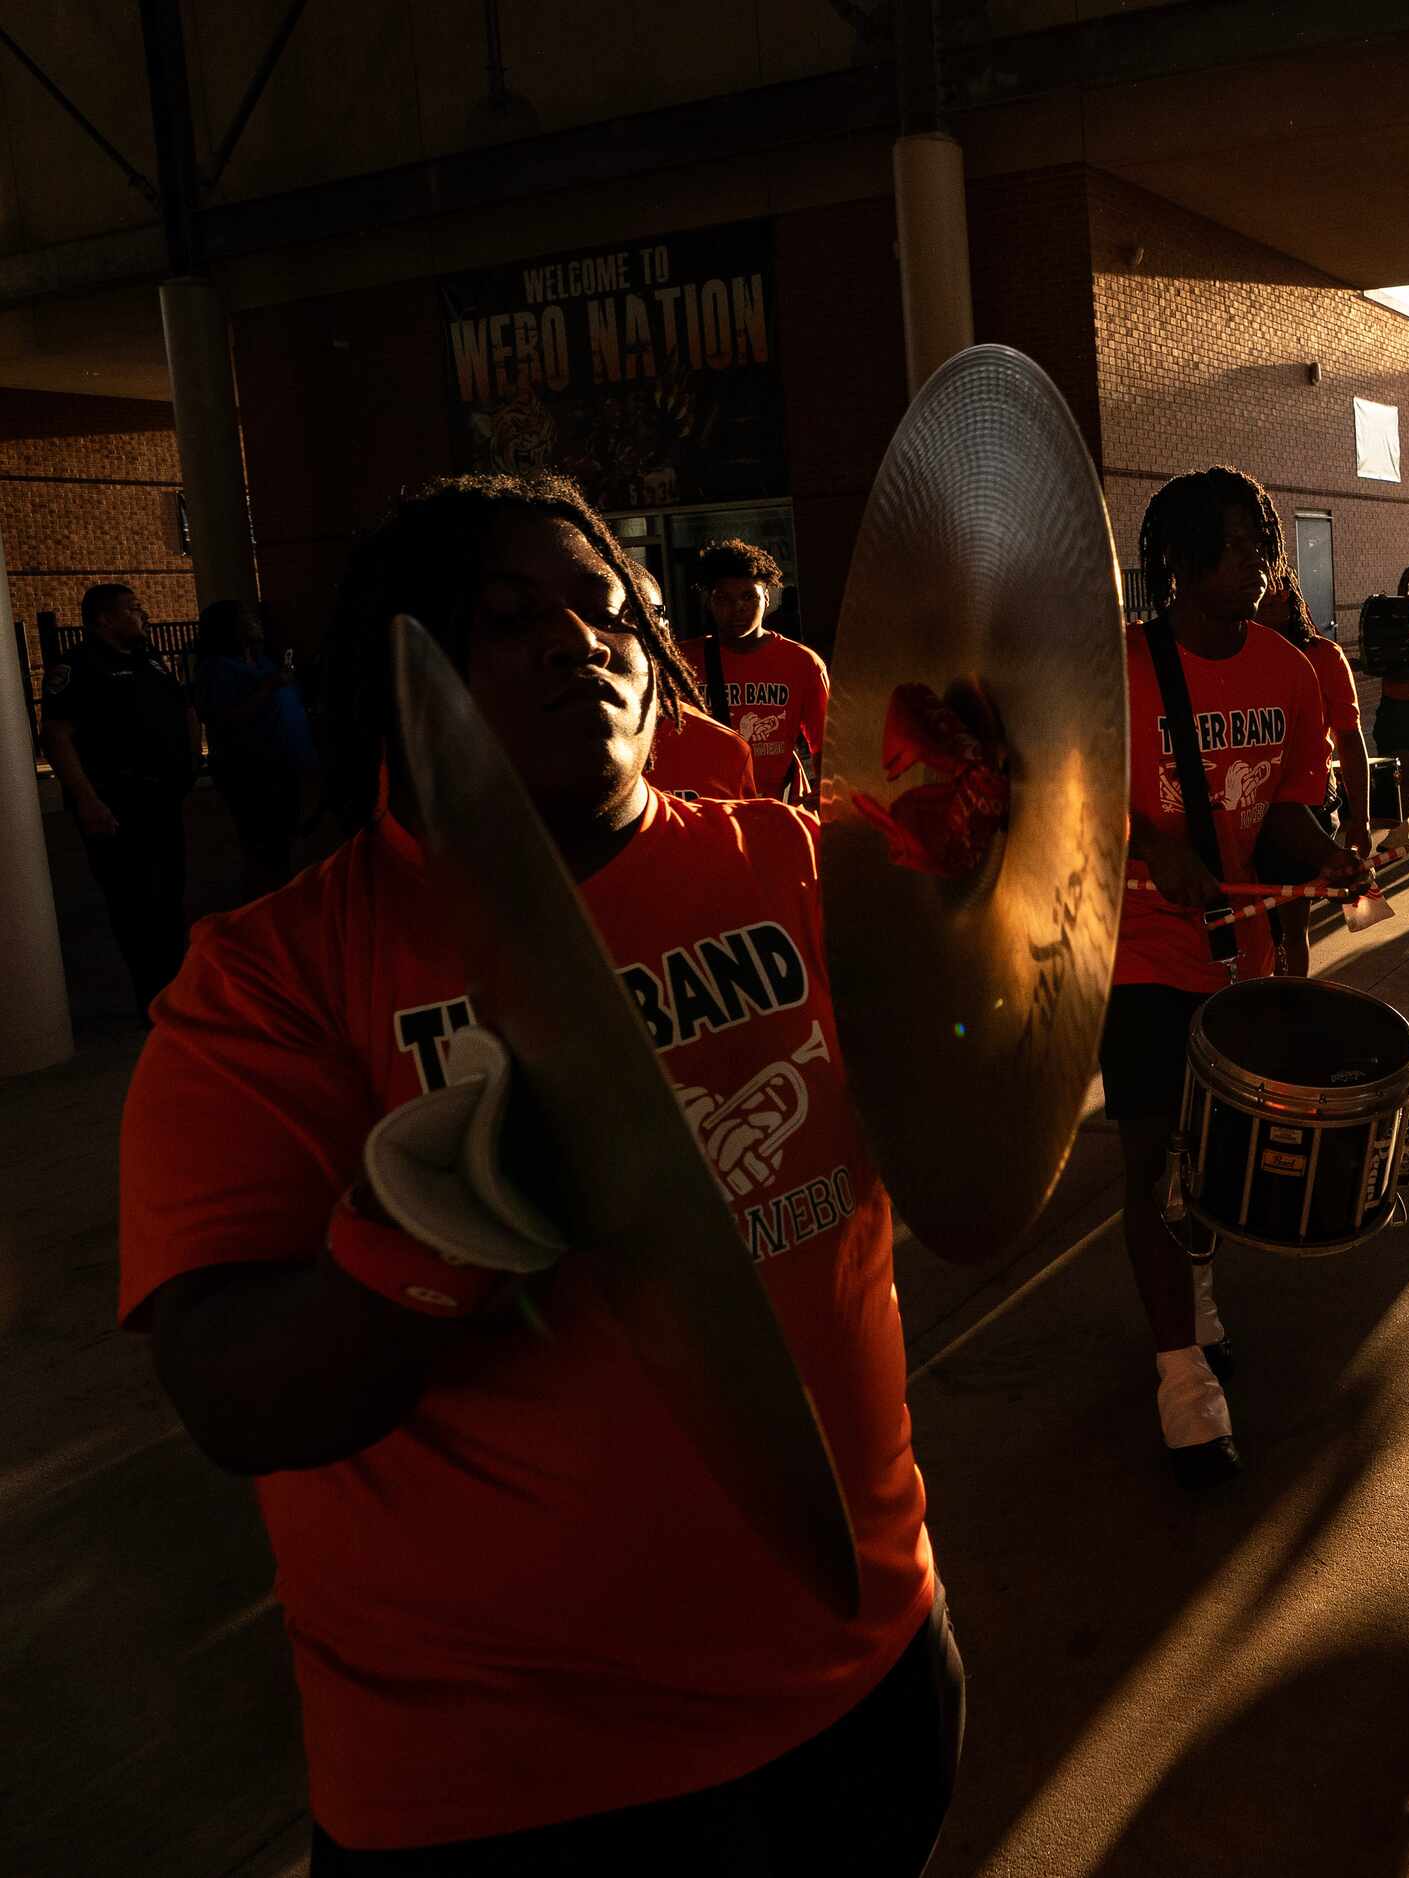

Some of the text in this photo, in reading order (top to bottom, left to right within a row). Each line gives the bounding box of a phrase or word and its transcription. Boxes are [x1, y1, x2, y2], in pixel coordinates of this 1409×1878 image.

[522, 244, 673, 305] WELCOME TO
[586, 271, 769, 385] NATION
[745, 682, 790, 708] BAND
[1229, 706, 1287, 749] BAND
[615, 920, 809, 1053] BAND
